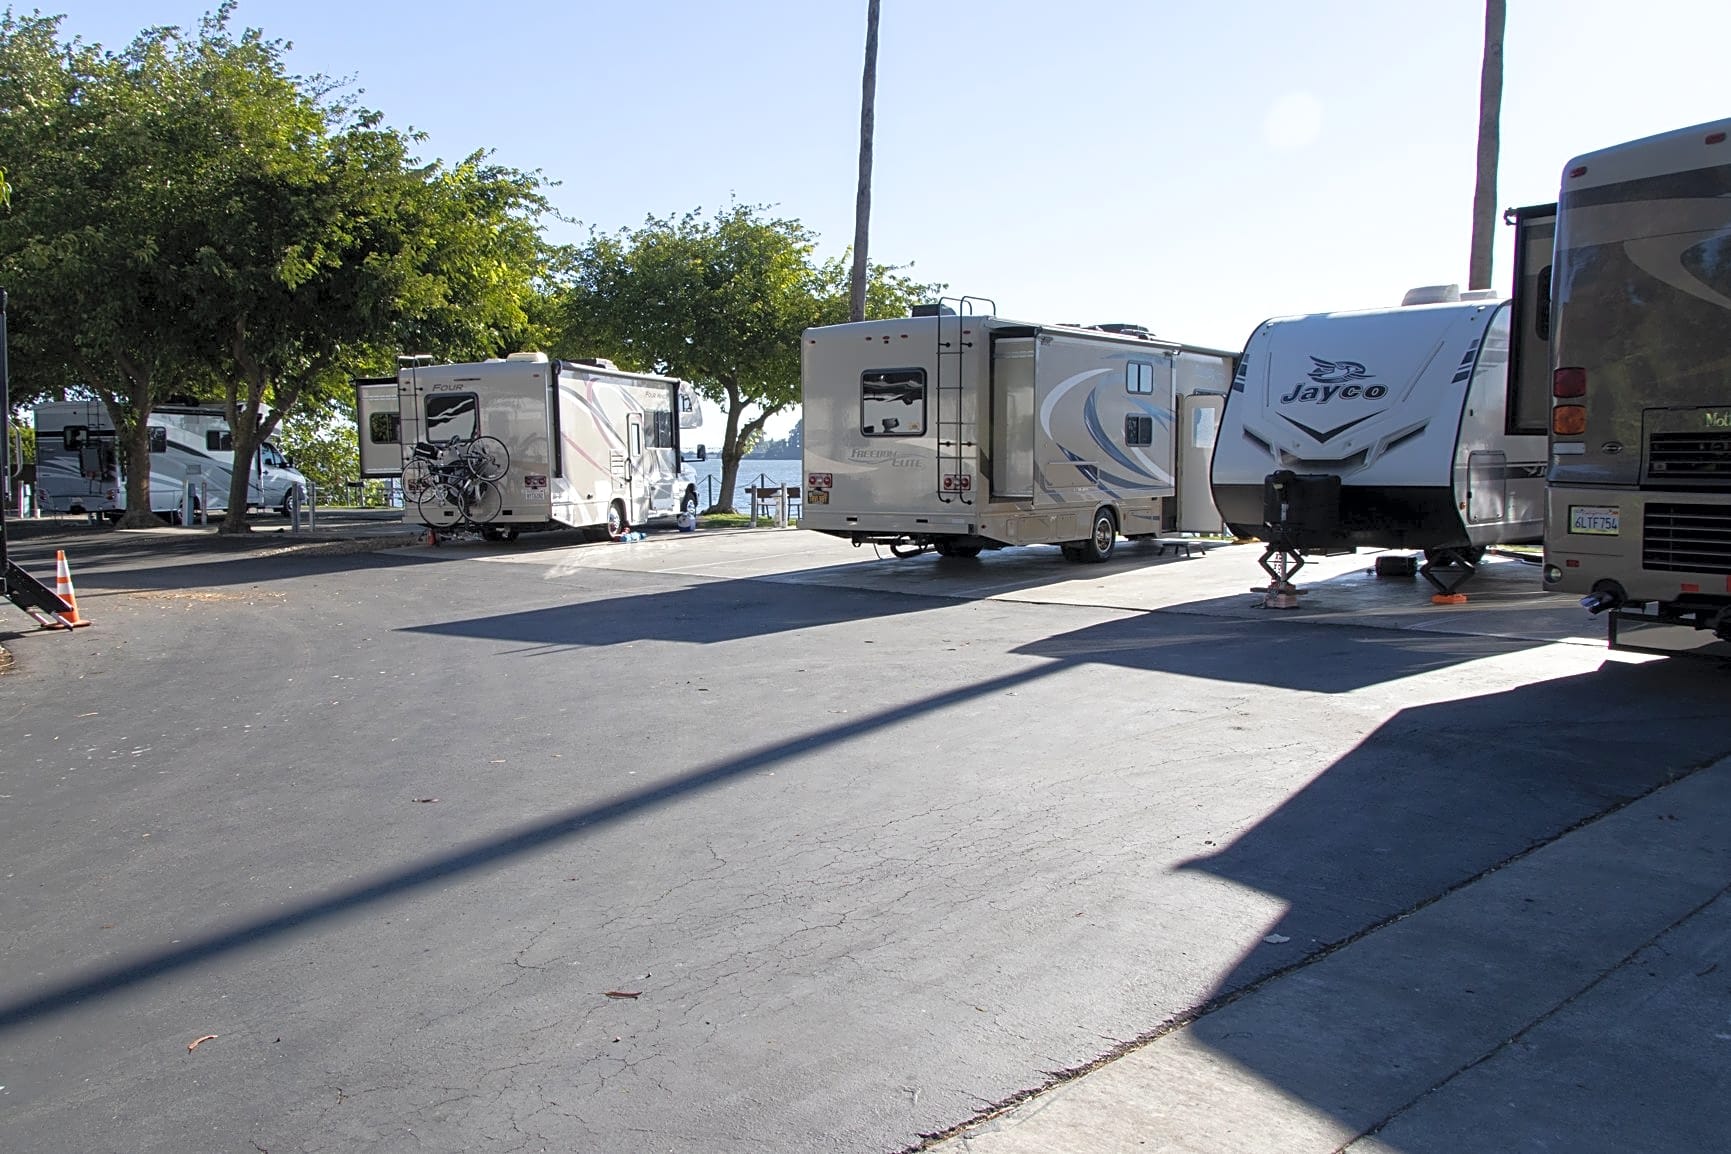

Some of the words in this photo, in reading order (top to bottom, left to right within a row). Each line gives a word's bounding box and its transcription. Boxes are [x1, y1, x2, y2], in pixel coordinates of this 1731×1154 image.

[432, 383, 464, 392] FOUR
[1281, 383, 1389, 404] Jayco
[1705, 411, 1731, 427] Mot
[1575, 516, 1618, 529] 6LTF754
